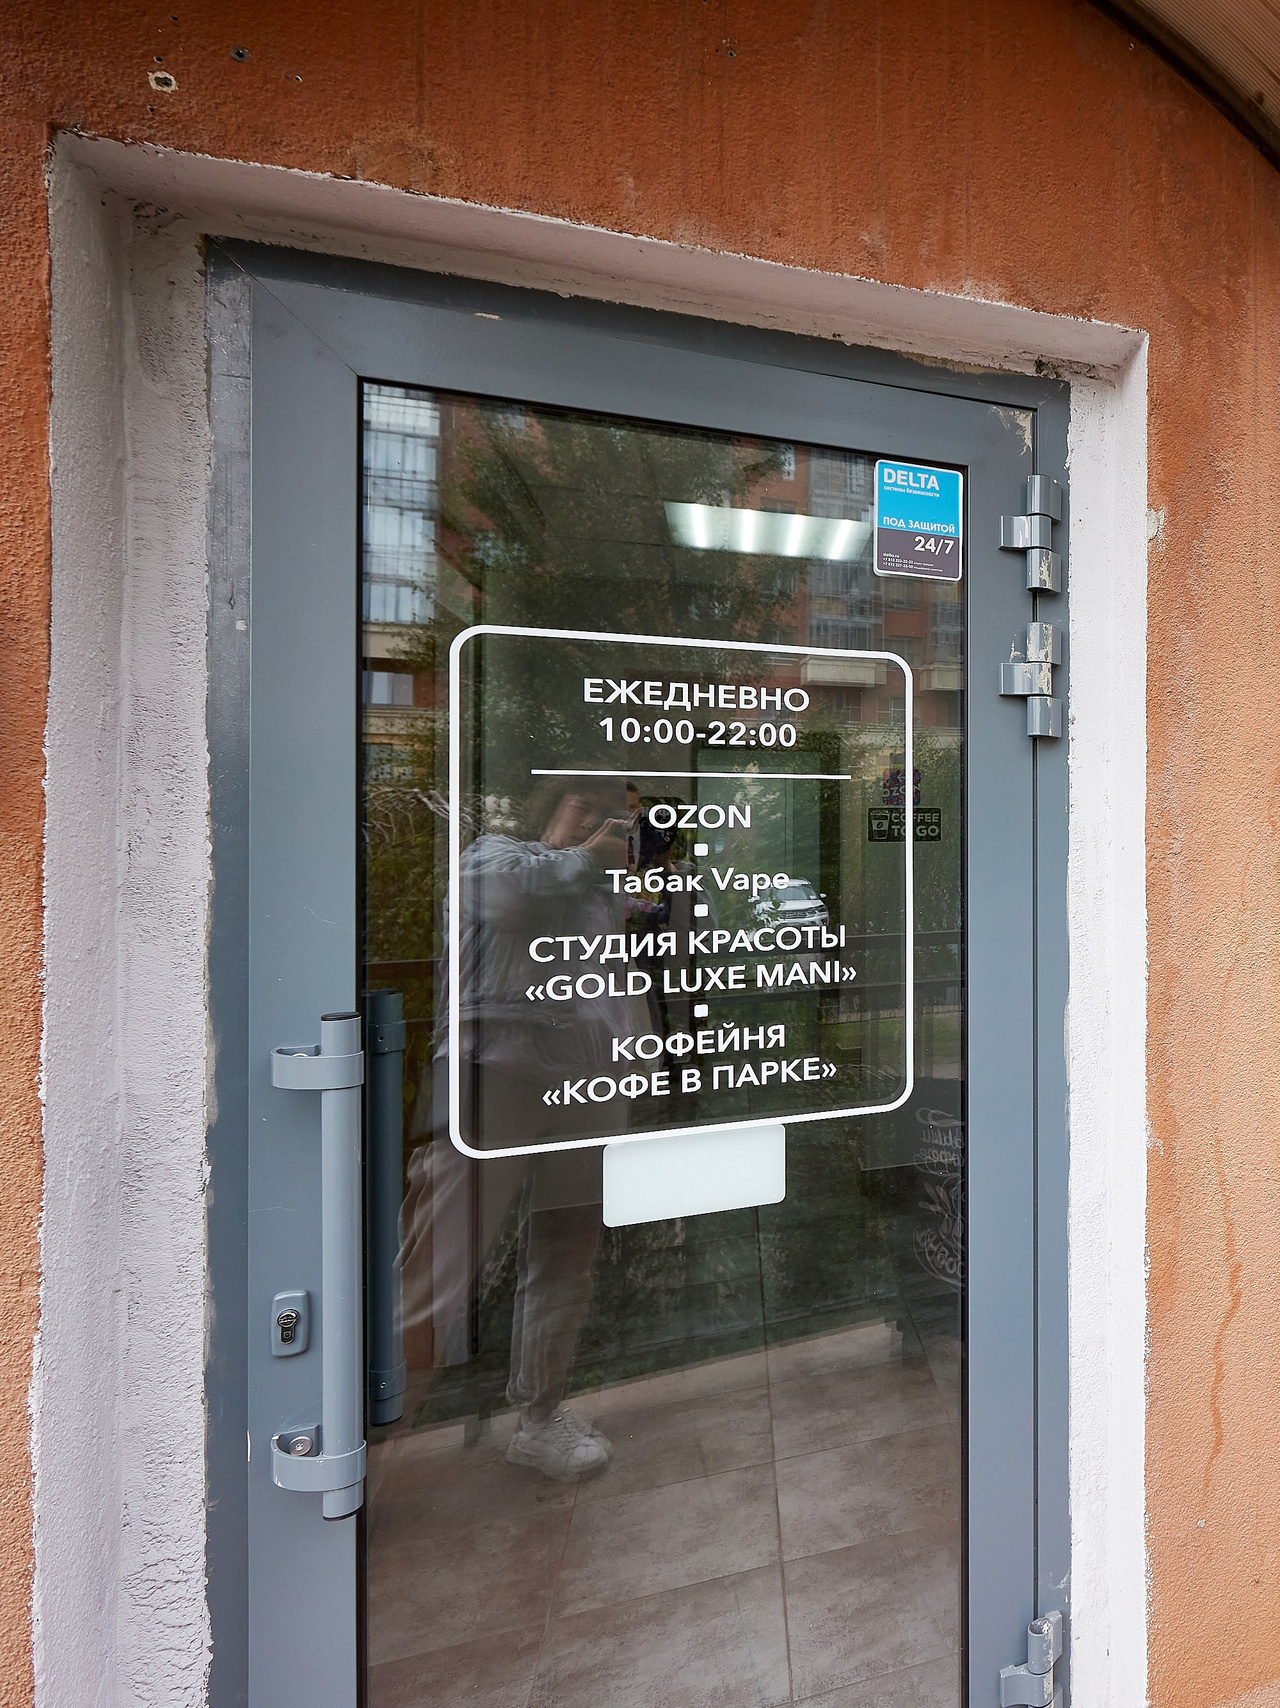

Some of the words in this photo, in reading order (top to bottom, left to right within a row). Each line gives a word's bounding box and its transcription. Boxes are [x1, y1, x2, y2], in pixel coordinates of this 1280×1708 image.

[883, 468, 940, 491] DELTA
[883, 516, 906, 528] ПОД
[908, 520, 955, 534] ЗАЩИТОЙ
[914, 536, 955, 555] 24/7
[583, 677, 810, 712] ЕЖЕДНЕВНО
[599, 717, 797, 747] 10:00-22:00
[648, 804, 751, 829] OZON
[916, 825, 939, 836] GO
[605, 866, 704, 894] Табак
[711, 867, 790, 897] Vape
[528, 931, 677, 965] СТУДИЯ
[688, 925, 846, 955] КРАСОТЫ
[525, 970, 652, 1002] «GOLD
[663, 965, 746, 994] LUXE
[756, 960, 857, 988] MANI»
[611, 1022, 786, 1062] КОФЕЙНЯ
[541, 1071, 670, 1107] «КОФЕ
[681, 1068, 702, 1094] В
[712, 1056, 838, 1090] ПАРКЕ»
